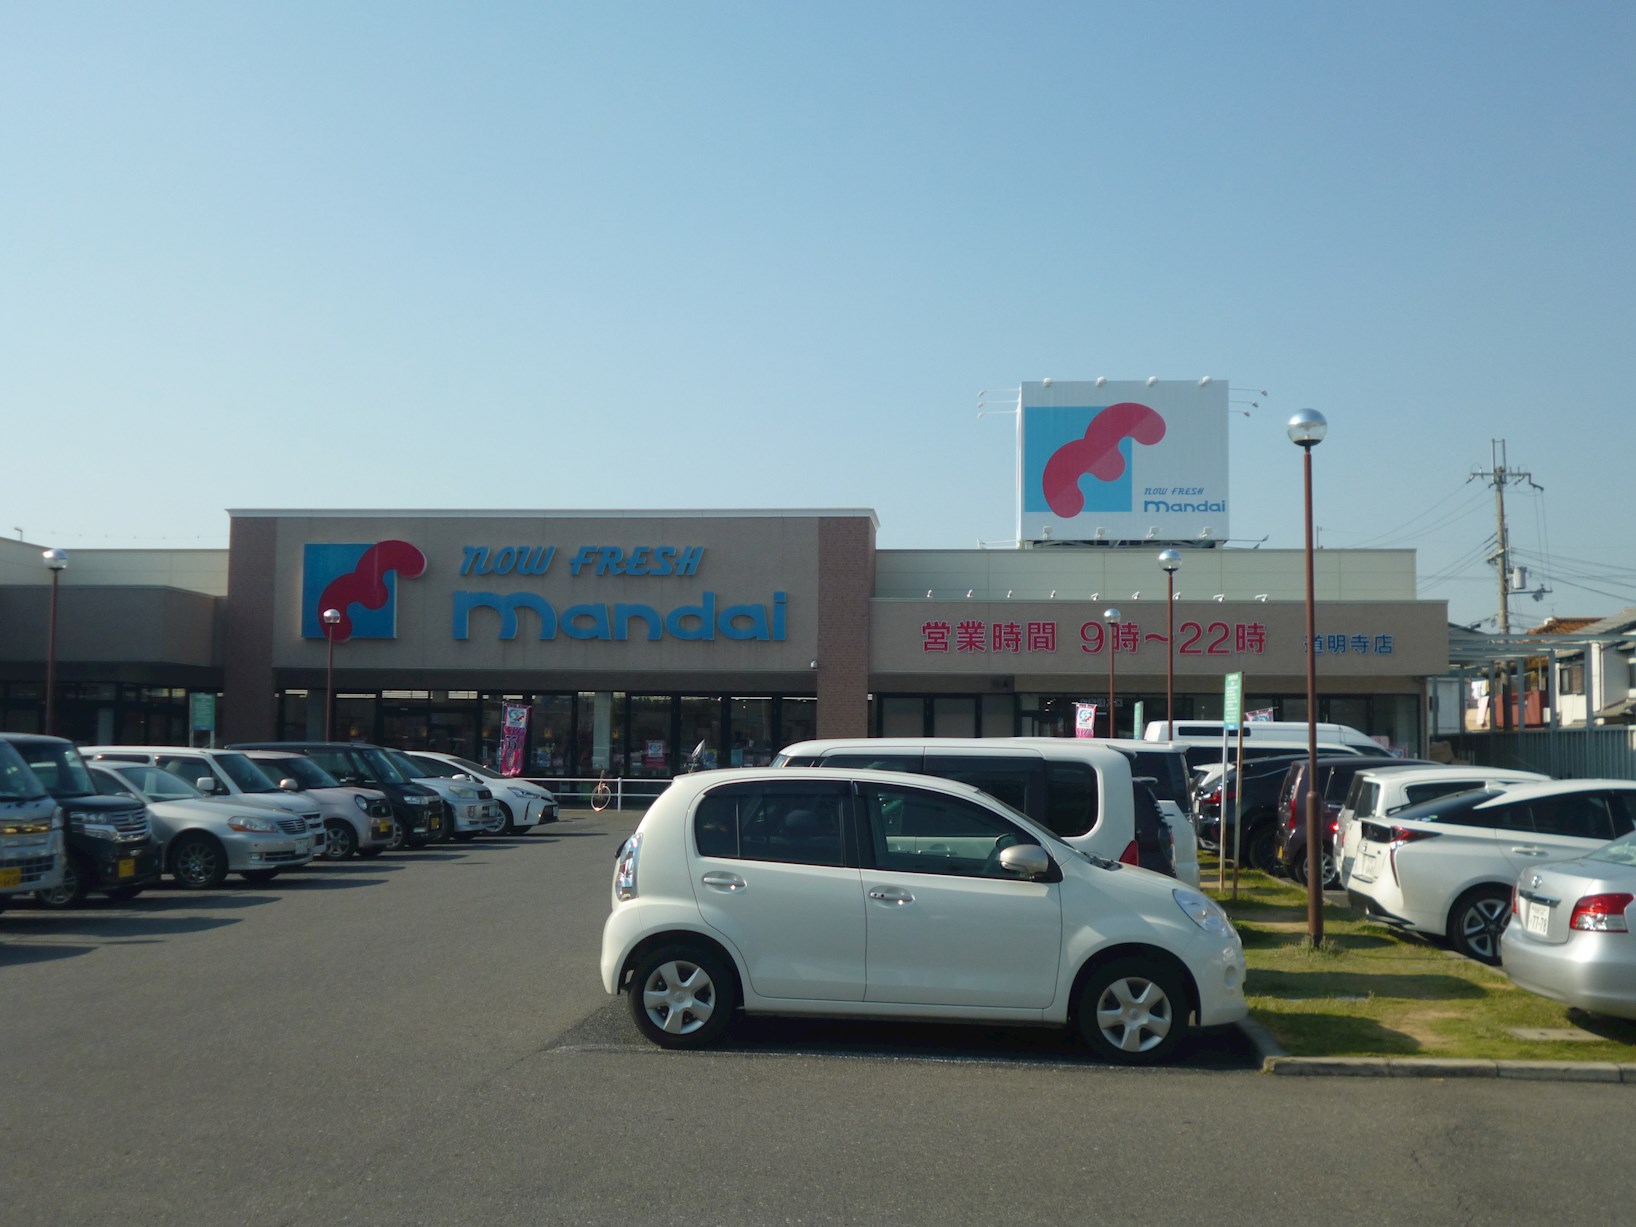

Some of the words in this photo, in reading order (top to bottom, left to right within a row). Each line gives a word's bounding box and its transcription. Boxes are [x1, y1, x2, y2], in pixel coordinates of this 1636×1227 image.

[1143, 500, 1226, 513] mandai
[1171, 487, 1205, 495] FRESH
[569, 545, 704, 577] FRESH
[452, 590, 787, 641] mandai
[921, 620, 1057, 653] 営業時間
